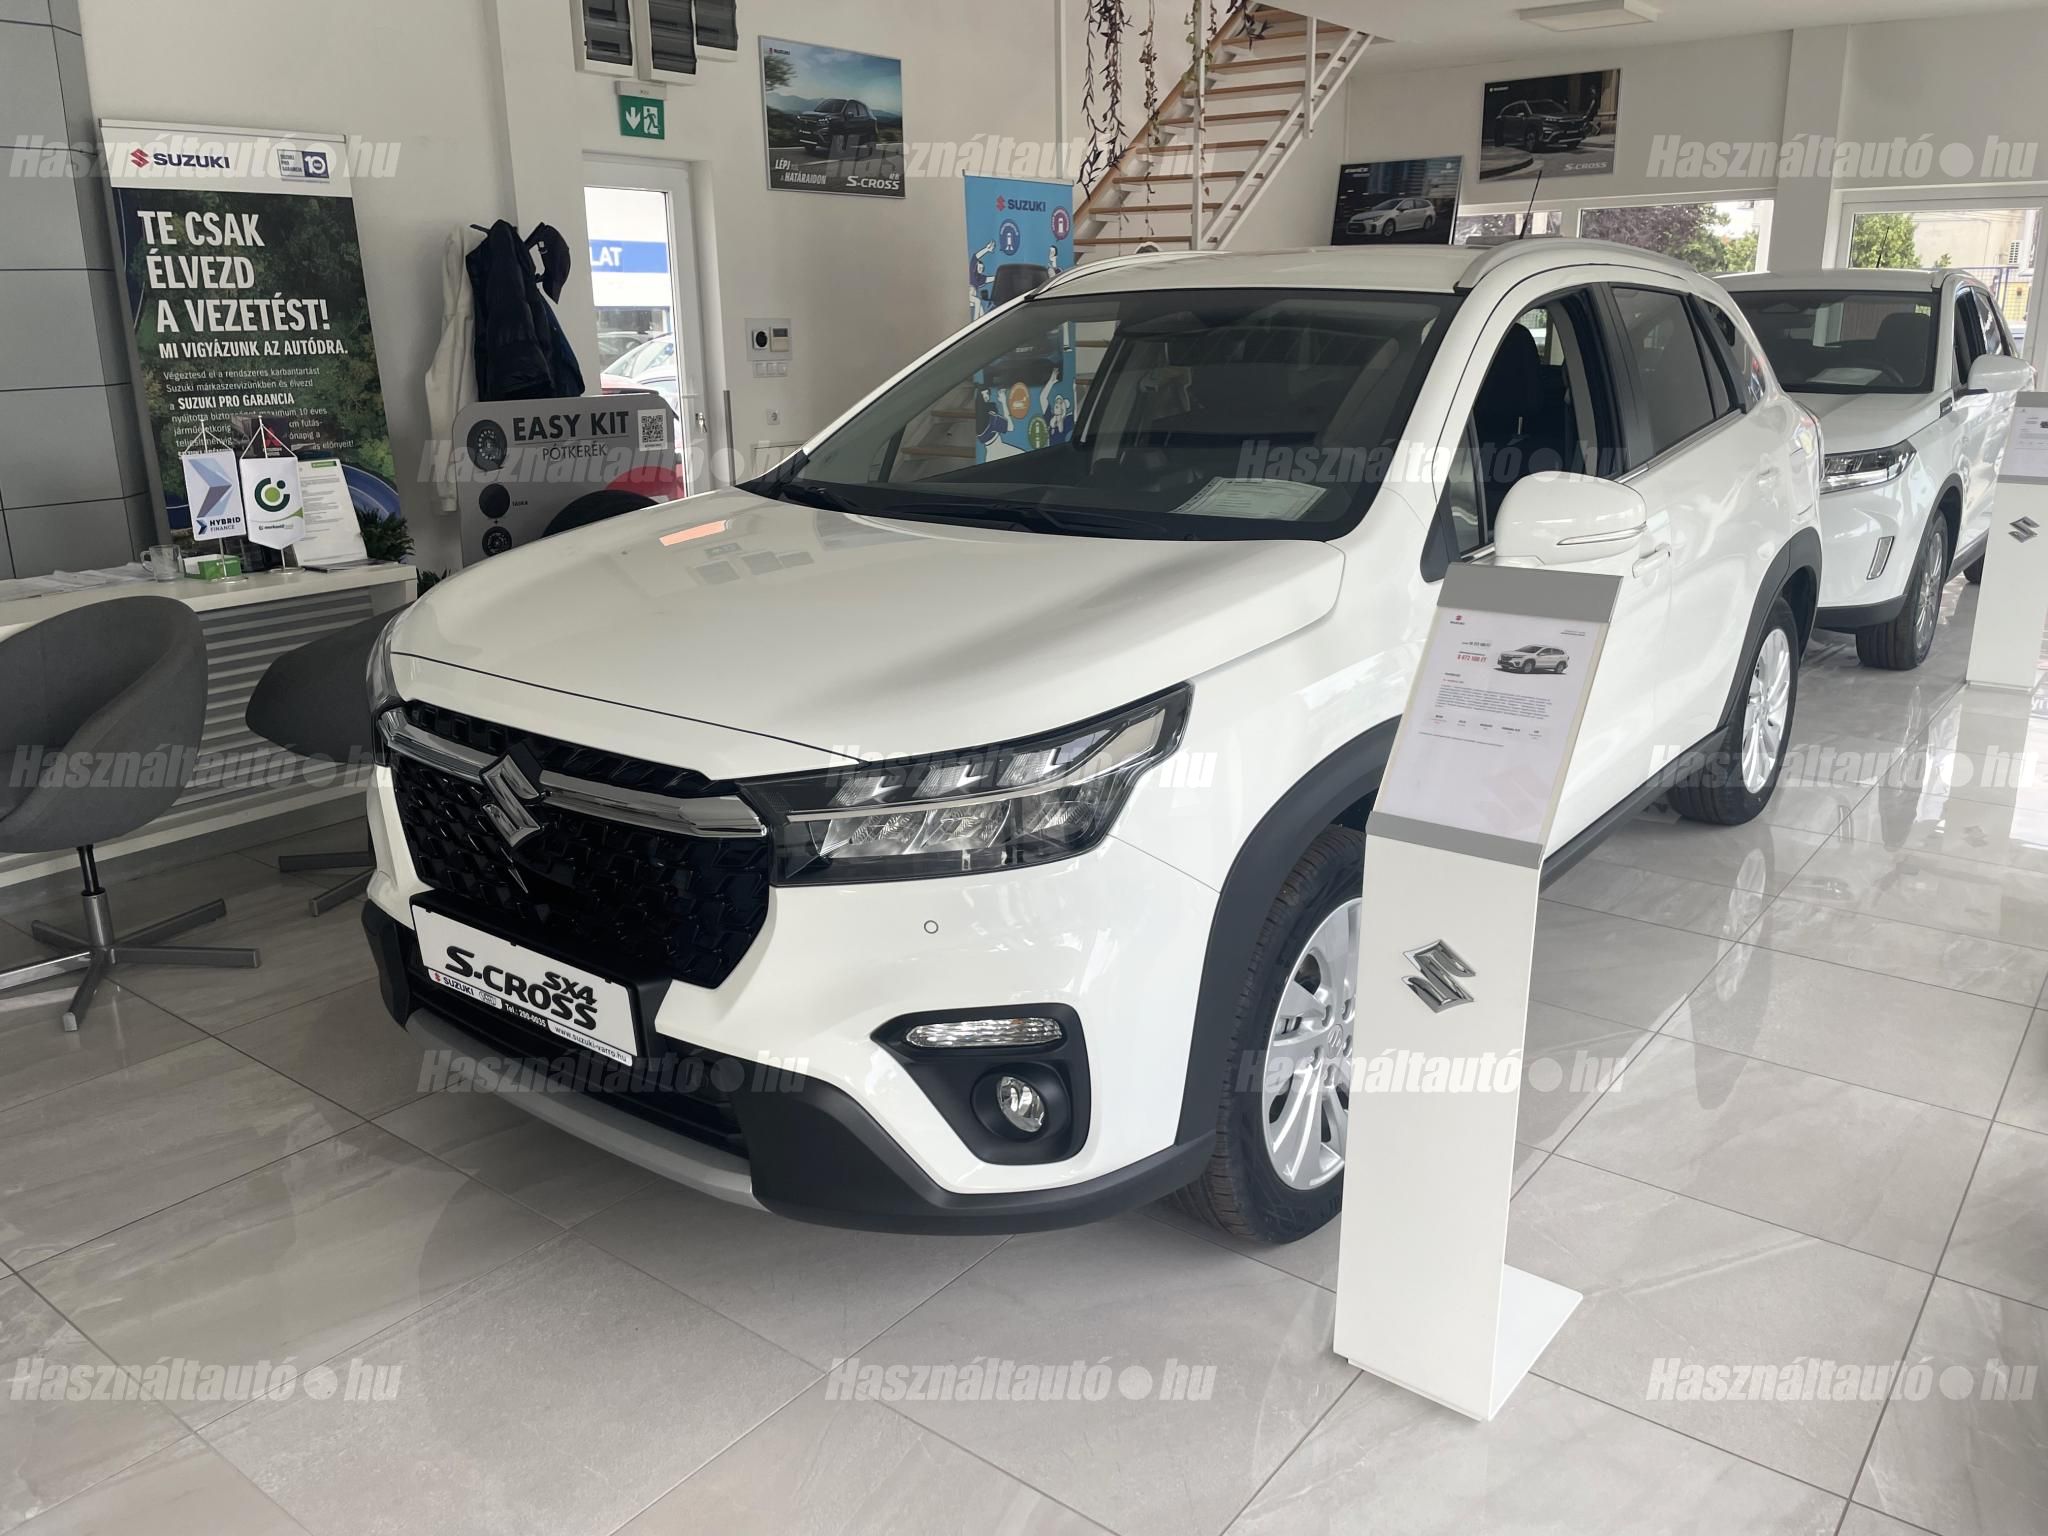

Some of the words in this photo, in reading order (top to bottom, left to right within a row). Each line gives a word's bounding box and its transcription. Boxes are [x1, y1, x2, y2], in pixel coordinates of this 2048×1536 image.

[153, 152, 230, 169] SUZUKI
[846, 175, 900, 190] S-CROSS
[1007, 198, 1046, 212] SUZUKI
[137, 210, 178, 245] TE
[185, 211, 265, 246] CSAK
[146, 248, 255, 289] ÉLVEZD
[156, 299, 179, 333] A
[185, 292, 331, 332] VEZETÉST!
[158, 343, 178, 359] MI
[181, 339, 260, 358] VIGYÁZUNK
[264, 341, 281, 357] AZ
[284, 339, 349, 355] AUTÓDRA.
[163, 370, 206, 382] Végeztesd
[225, 368, 268, 378] rendszeres
[271, 367, 320, 377] karbantartást
[166, 383, 194, 393] Suzuki
[177, 396, 216, 410] SUZUKI
[219, 395, 240, 408] PRO
[242, 392, 295, 407] GARANCIA
[299, 407, 309, 416] 10
[310, 407, 328, 416] éves
[512, 413, 581, 441] EASY
[590, 411, 629, 436] KIT
[542, 440, 607, 461] PÓTKERÉK
[209, 516, 241, 526] HYBRID
[443, 976, 475, 996] SUZUKI
[445, 945, 598, 1031] S-CROSS
[542, 971, 598, 1005] SX4
